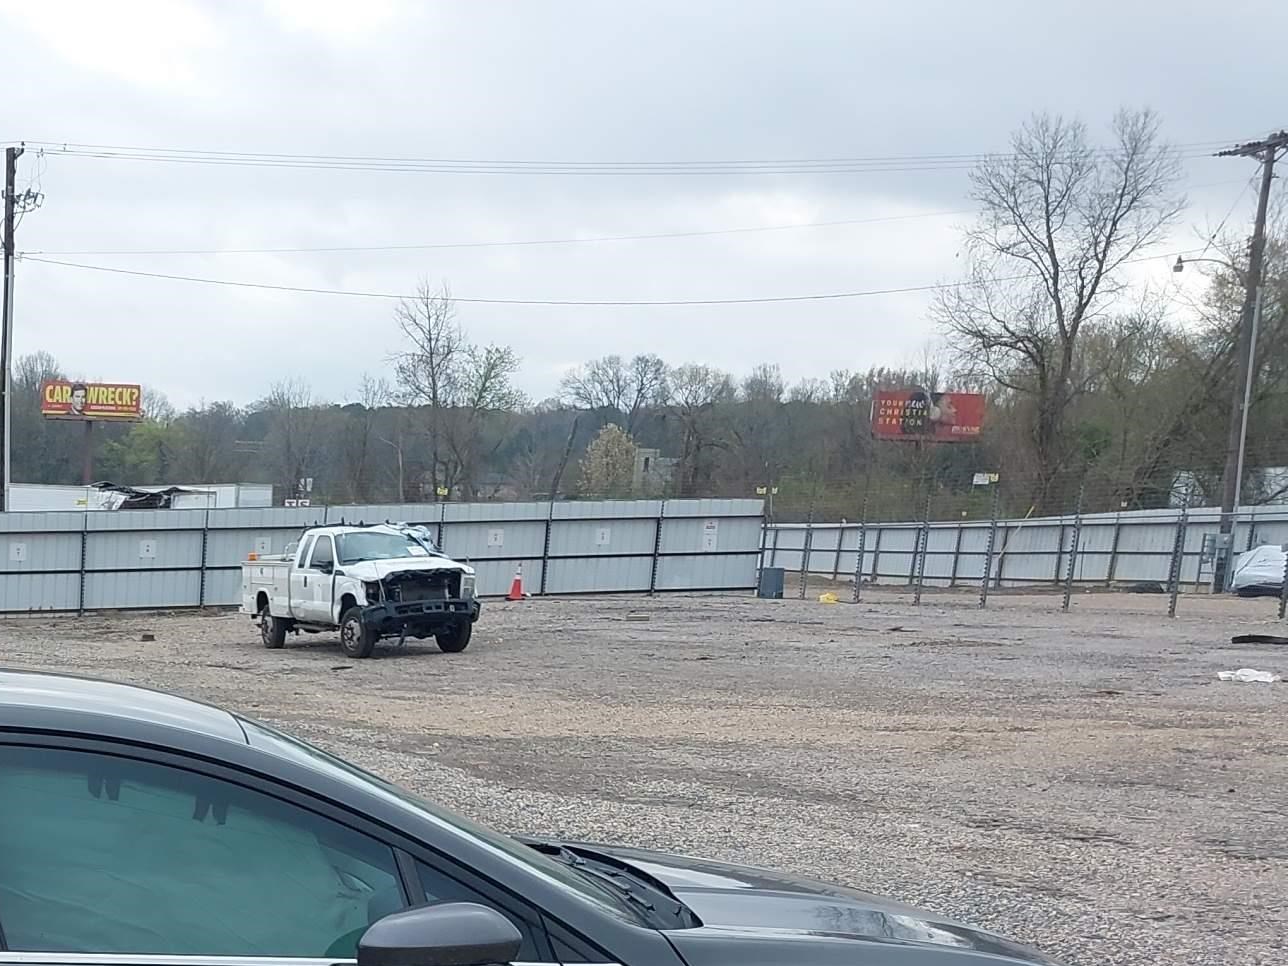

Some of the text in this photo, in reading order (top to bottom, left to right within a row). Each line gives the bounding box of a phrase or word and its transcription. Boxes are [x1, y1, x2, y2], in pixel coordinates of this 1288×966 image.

[45, 385, 139, 405] CAR WRECK?
[879, 407, 928, 416] CHRISTIA
